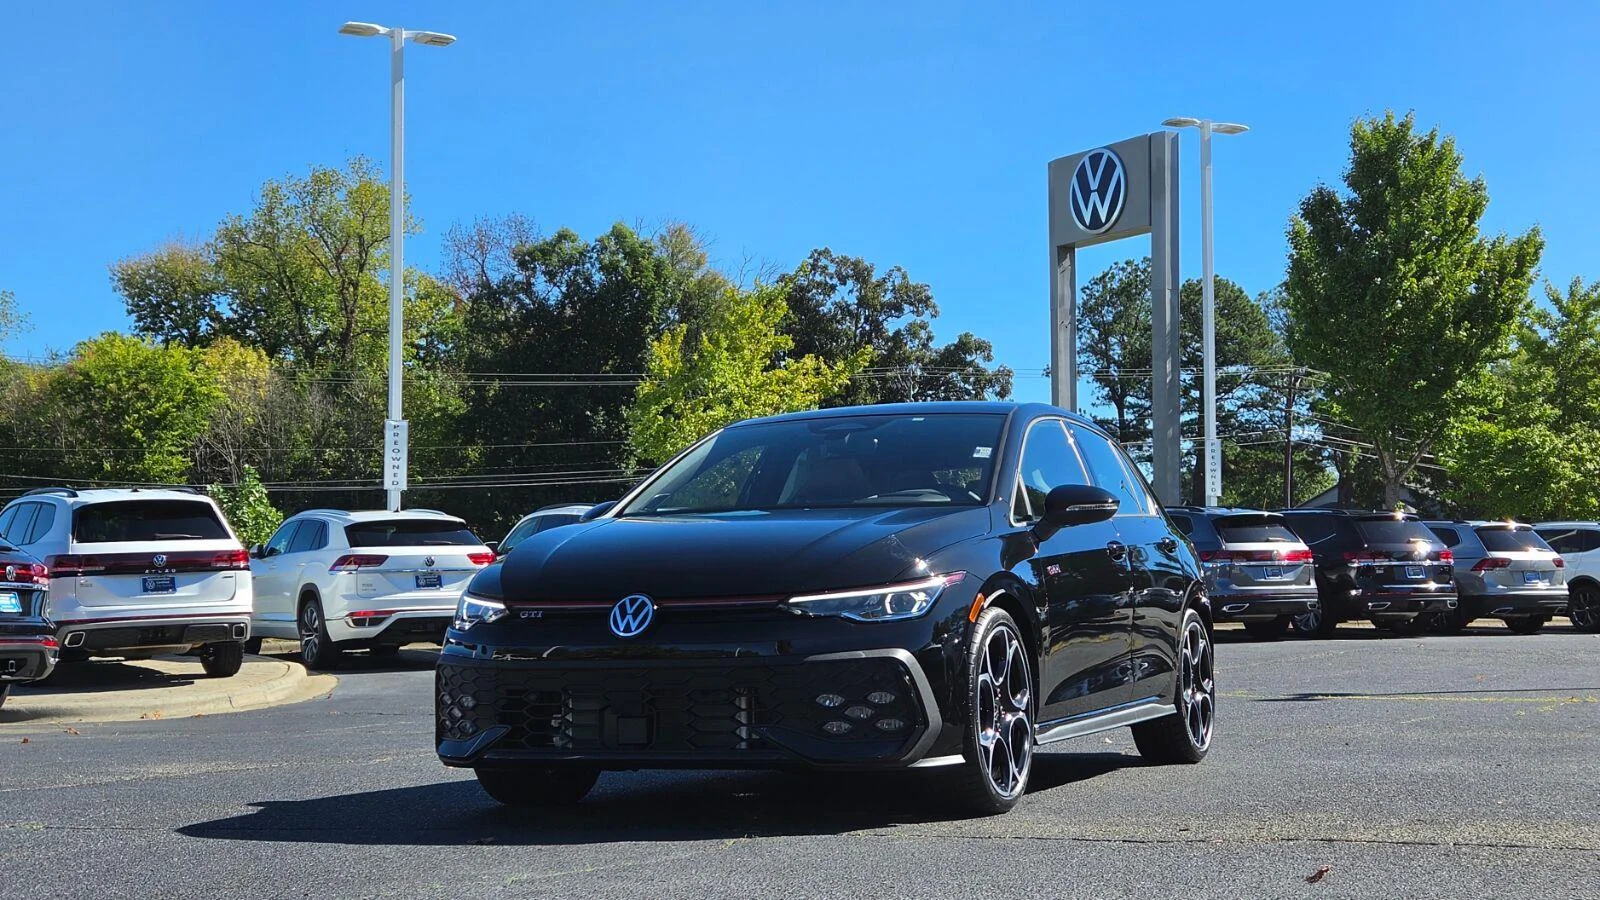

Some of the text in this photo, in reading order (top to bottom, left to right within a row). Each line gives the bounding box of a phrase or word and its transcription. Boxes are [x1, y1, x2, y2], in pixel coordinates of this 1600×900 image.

[1070, 148, 1125, 234] VW
[391, 424, 401, 486] PREOWNED
[153, 554, 167, 568] VW
[519, 610, 543, 619] GTI
[610, 594, 653, 637] VW
